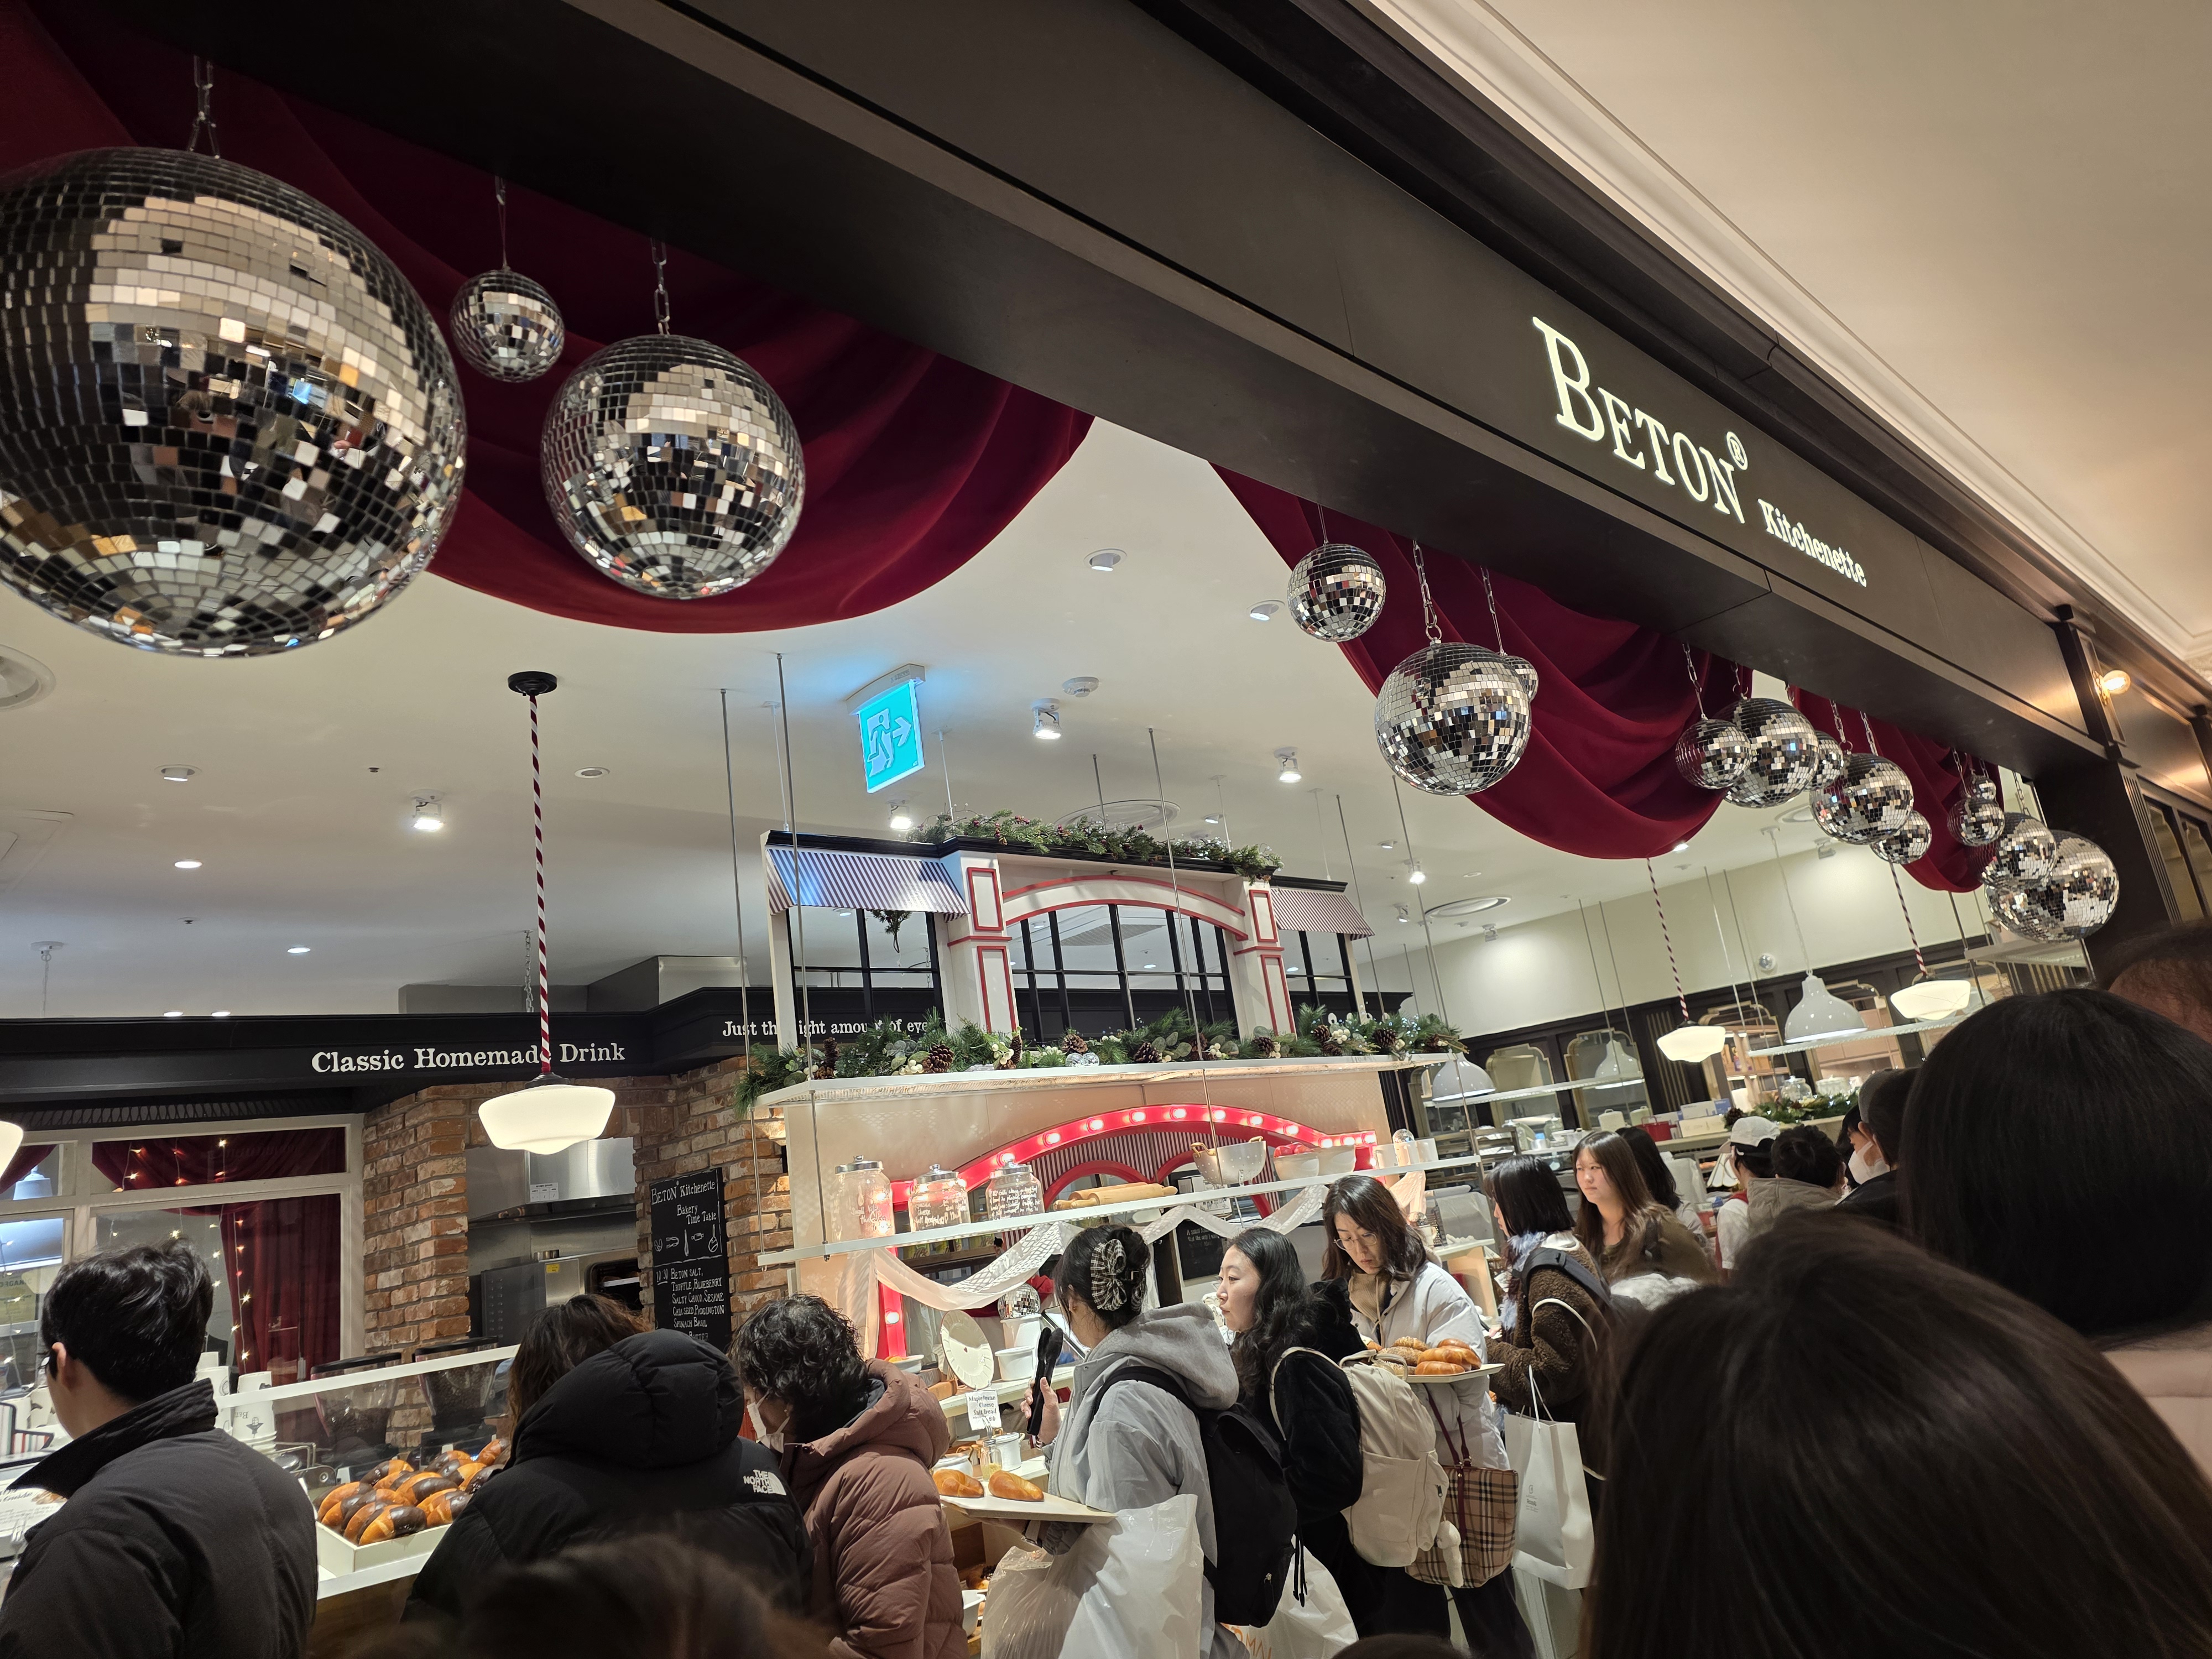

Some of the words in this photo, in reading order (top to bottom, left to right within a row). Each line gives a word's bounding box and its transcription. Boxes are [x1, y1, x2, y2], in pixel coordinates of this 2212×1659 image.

[1758, 498, 1867, 587] Kitchenette
[722, 1021, 758, 1037] Just
[761, 1021, 778, 1036] th
[799, 1020, 826, 1037] ight
[311, 1049, 405, 1073] Classic
[559, 1042, 625, 1063] Drink
[680, 1180, 716, 1197] Kitchenette
[676, 1204, 698, 1216] Bakery
[686, 1214, 701, 1225] Time
[701, 1211, 717, 1222] Table
[674, 1317, 693, 1328] SPINACH
[693, 1316, 708, 1327] BASIL
[743, 1475, 770, 1486] NORTH
[753, 1469, 769, 1479] THE
[752, 1484, 773, 1494] FACE
